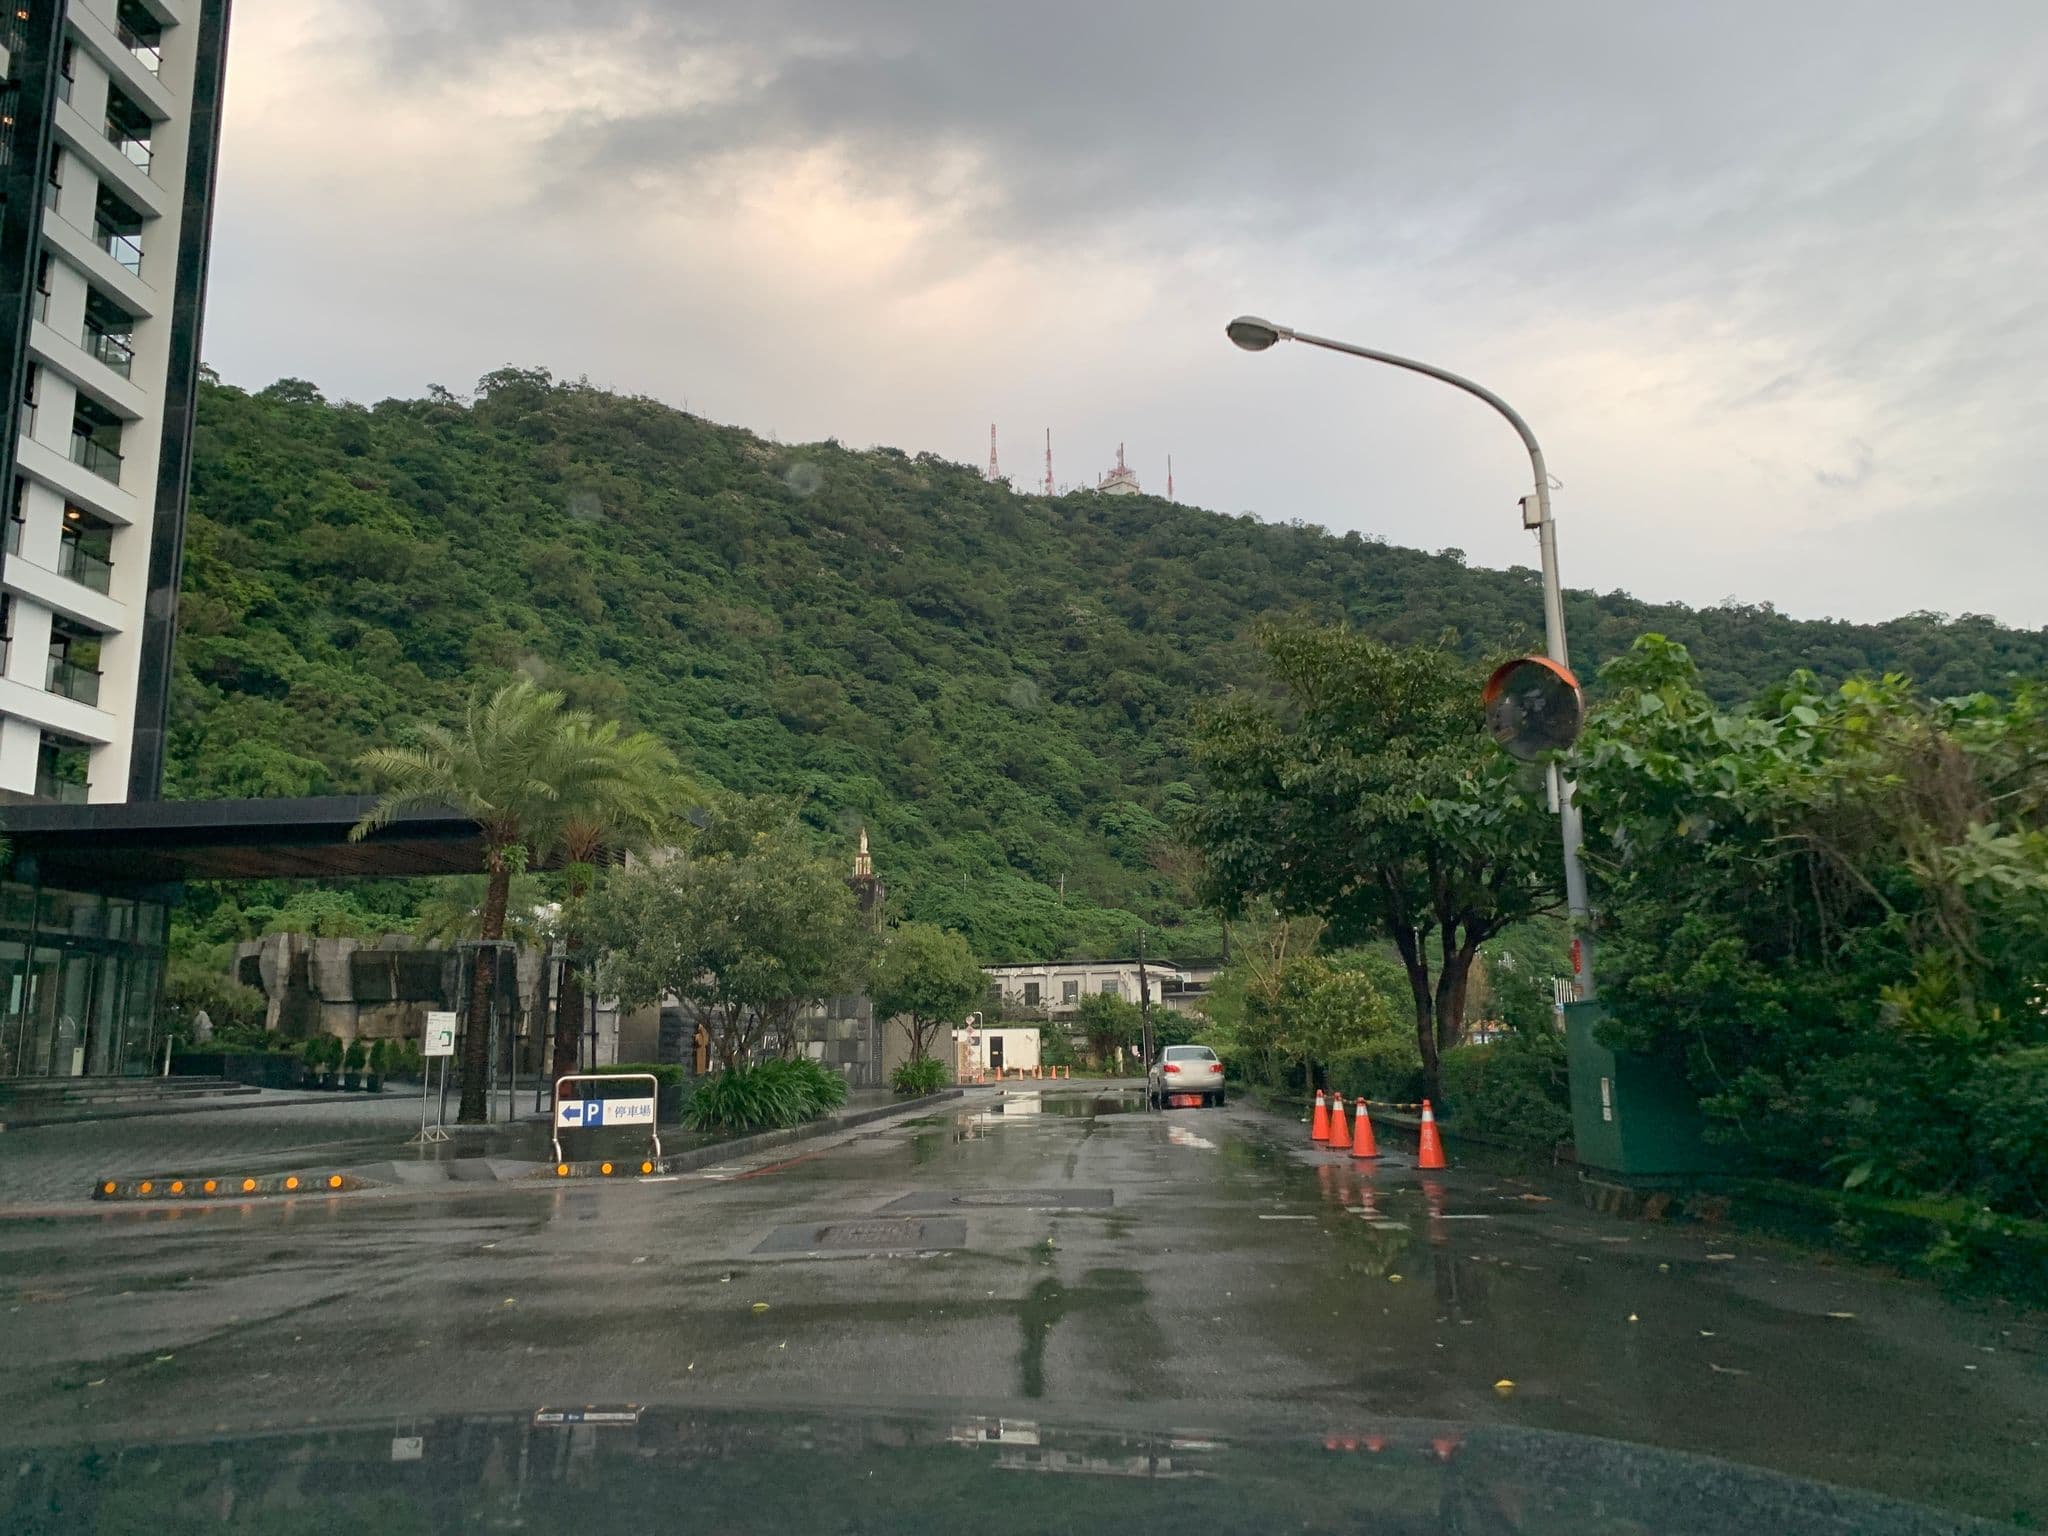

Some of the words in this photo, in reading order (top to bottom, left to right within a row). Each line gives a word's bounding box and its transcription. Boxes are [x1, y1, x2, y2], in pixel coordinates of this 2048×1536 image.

[587, 1104, 599, 1122] P
[614, 1104, 651, 1118] 停車場
